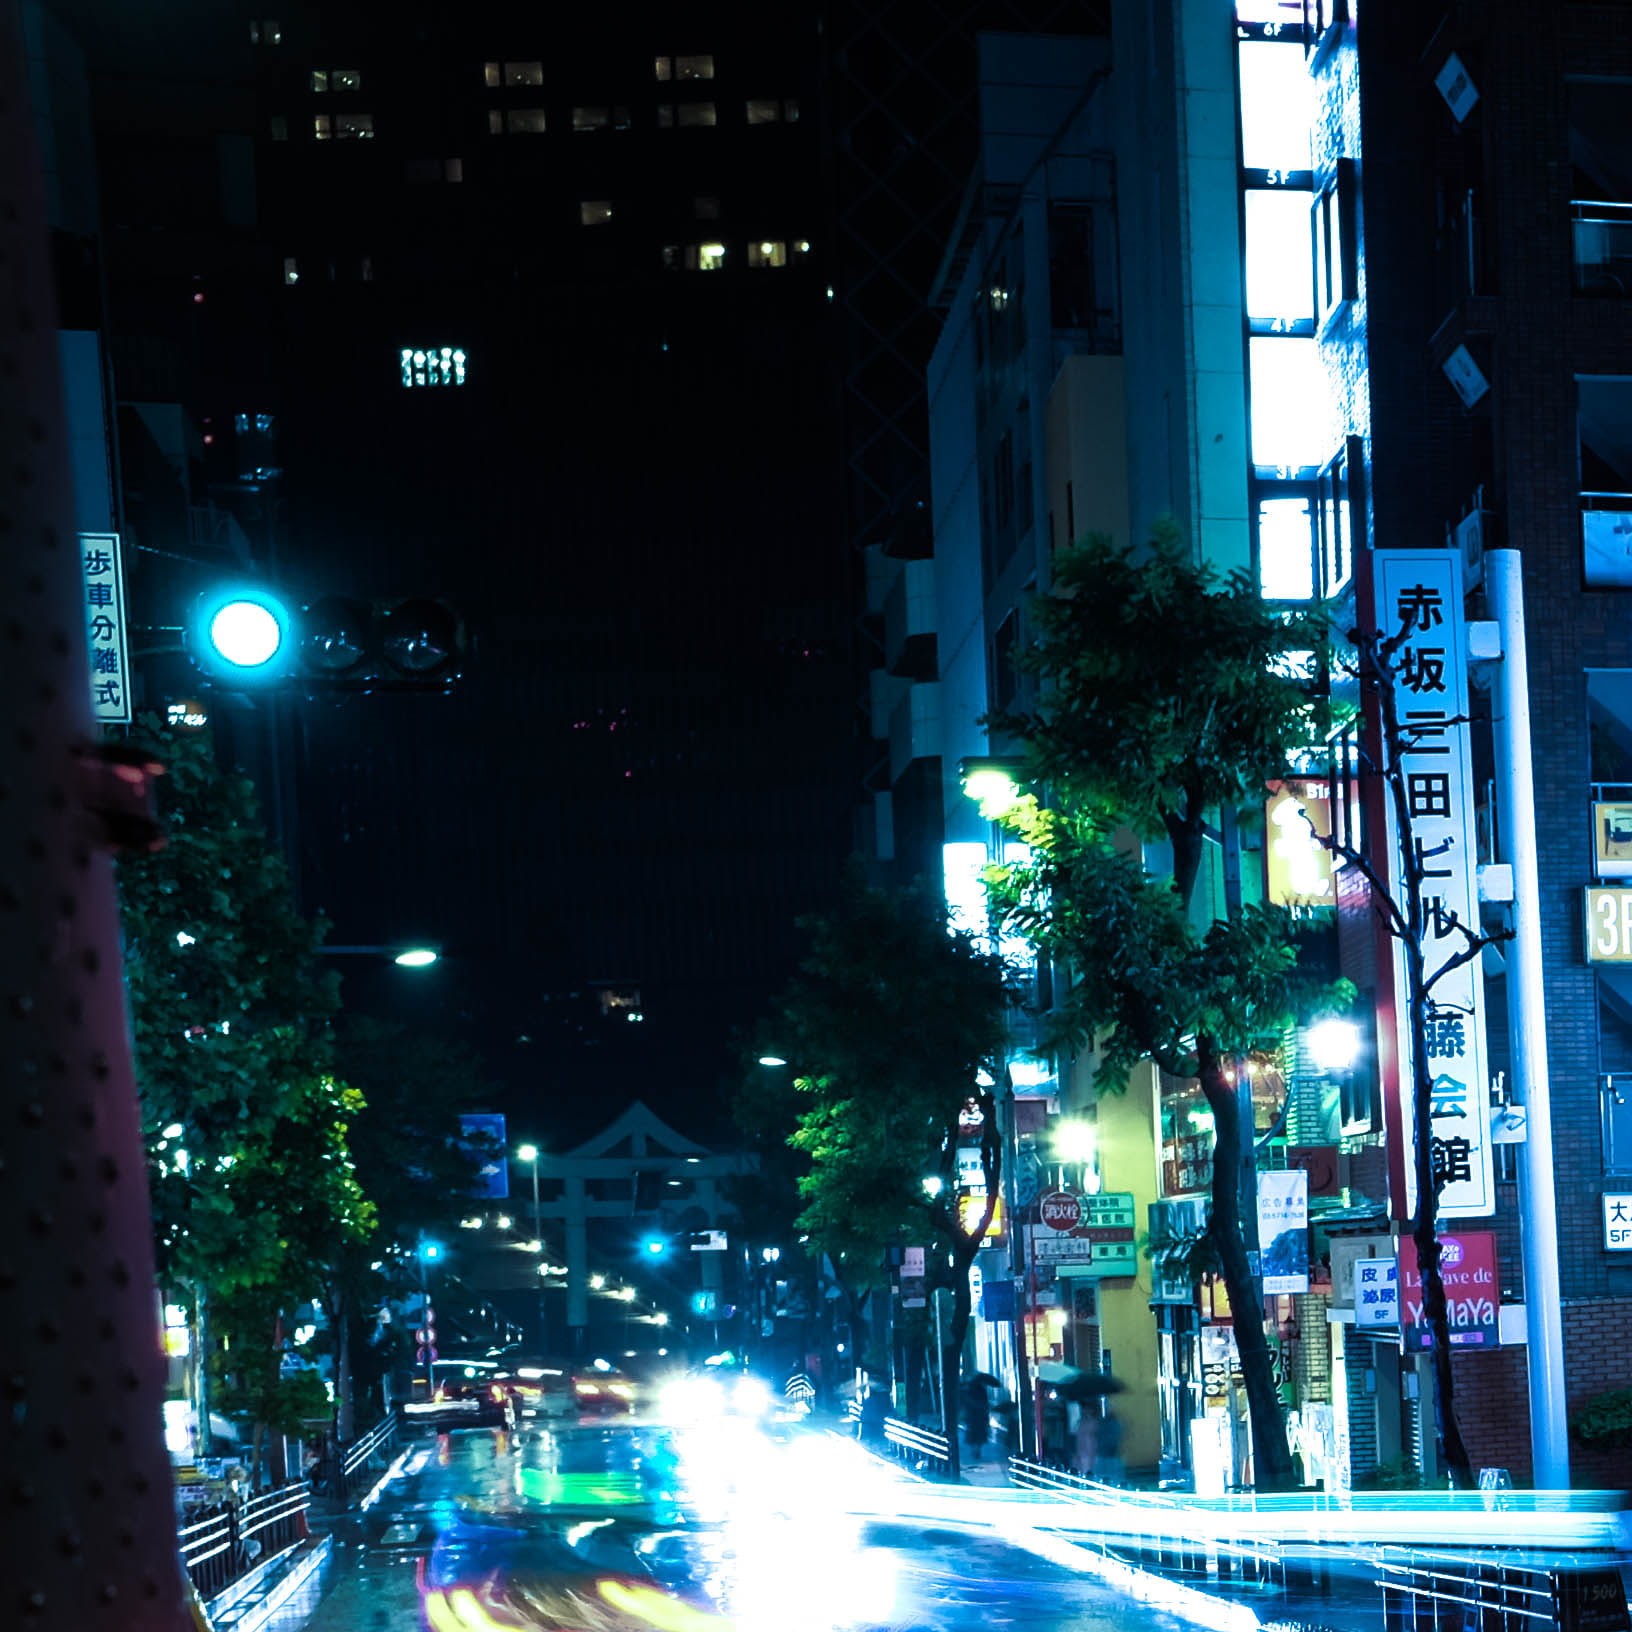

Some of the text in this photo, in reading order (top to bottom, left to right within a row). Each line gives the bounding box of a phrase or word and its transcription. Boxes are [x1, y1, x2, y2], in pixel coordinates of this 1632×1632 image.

[84, 550, 121, 707] 歩車分離式
[1610, 1230, 1632, 1242] 5F
[1473, 1267, 1493, 1284] de
[1374, 1309, 1390, 1320] 5F
